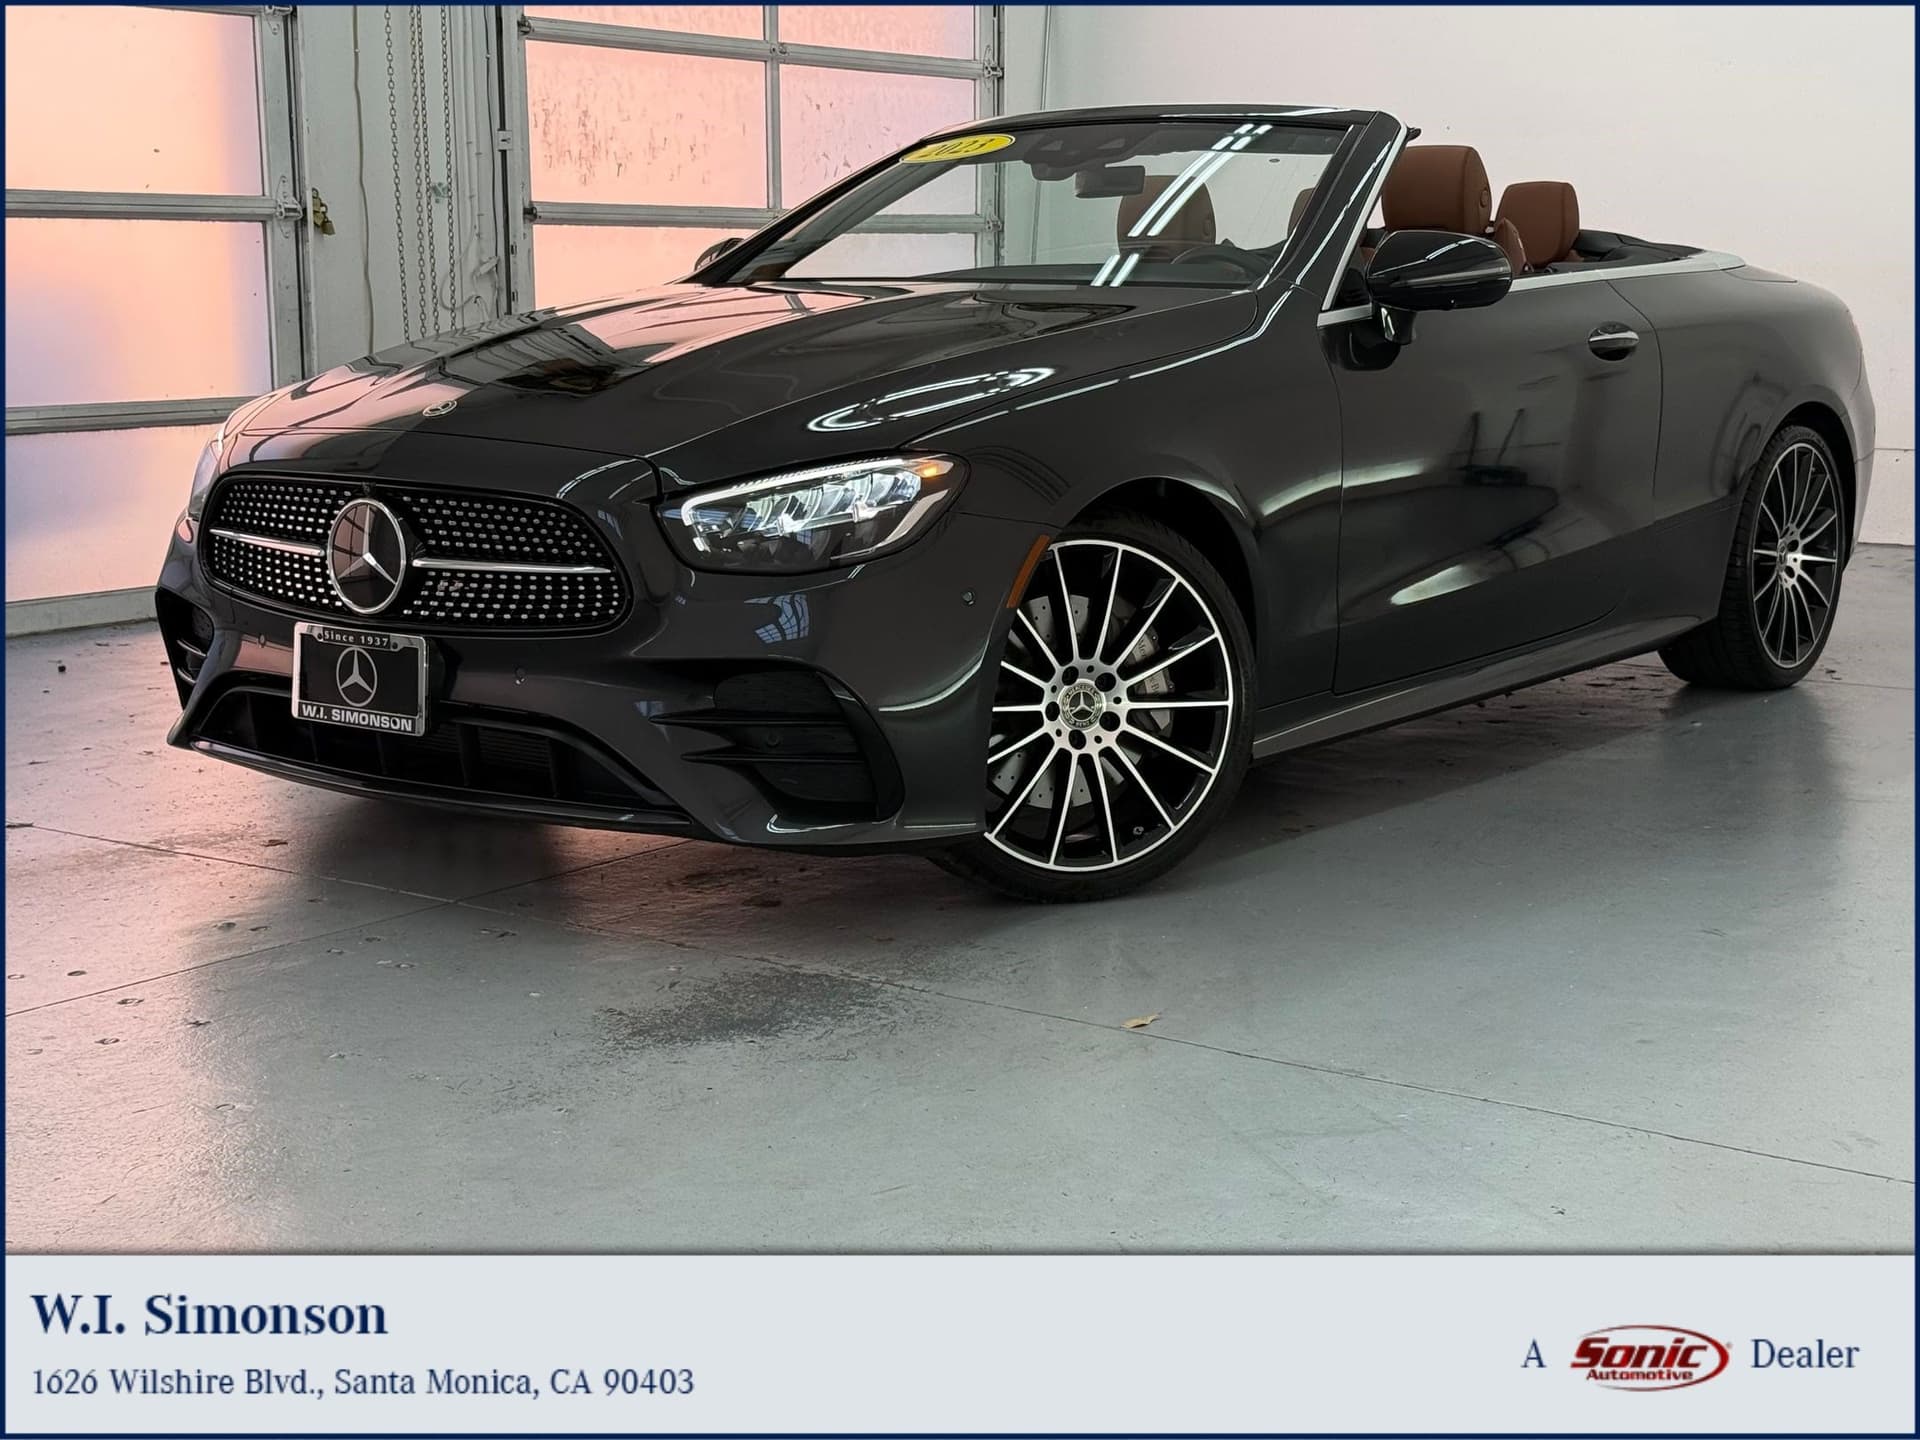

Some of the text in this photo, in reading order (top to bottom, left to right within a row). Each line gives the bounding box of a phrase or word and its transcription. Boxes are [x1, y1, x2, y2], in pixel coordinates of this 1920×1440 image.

[916, 138, 996, 158] 2023
[324, 630, 389, 647] Since 1937
[302, 704, 412, 731] W.I. SIMONSON
